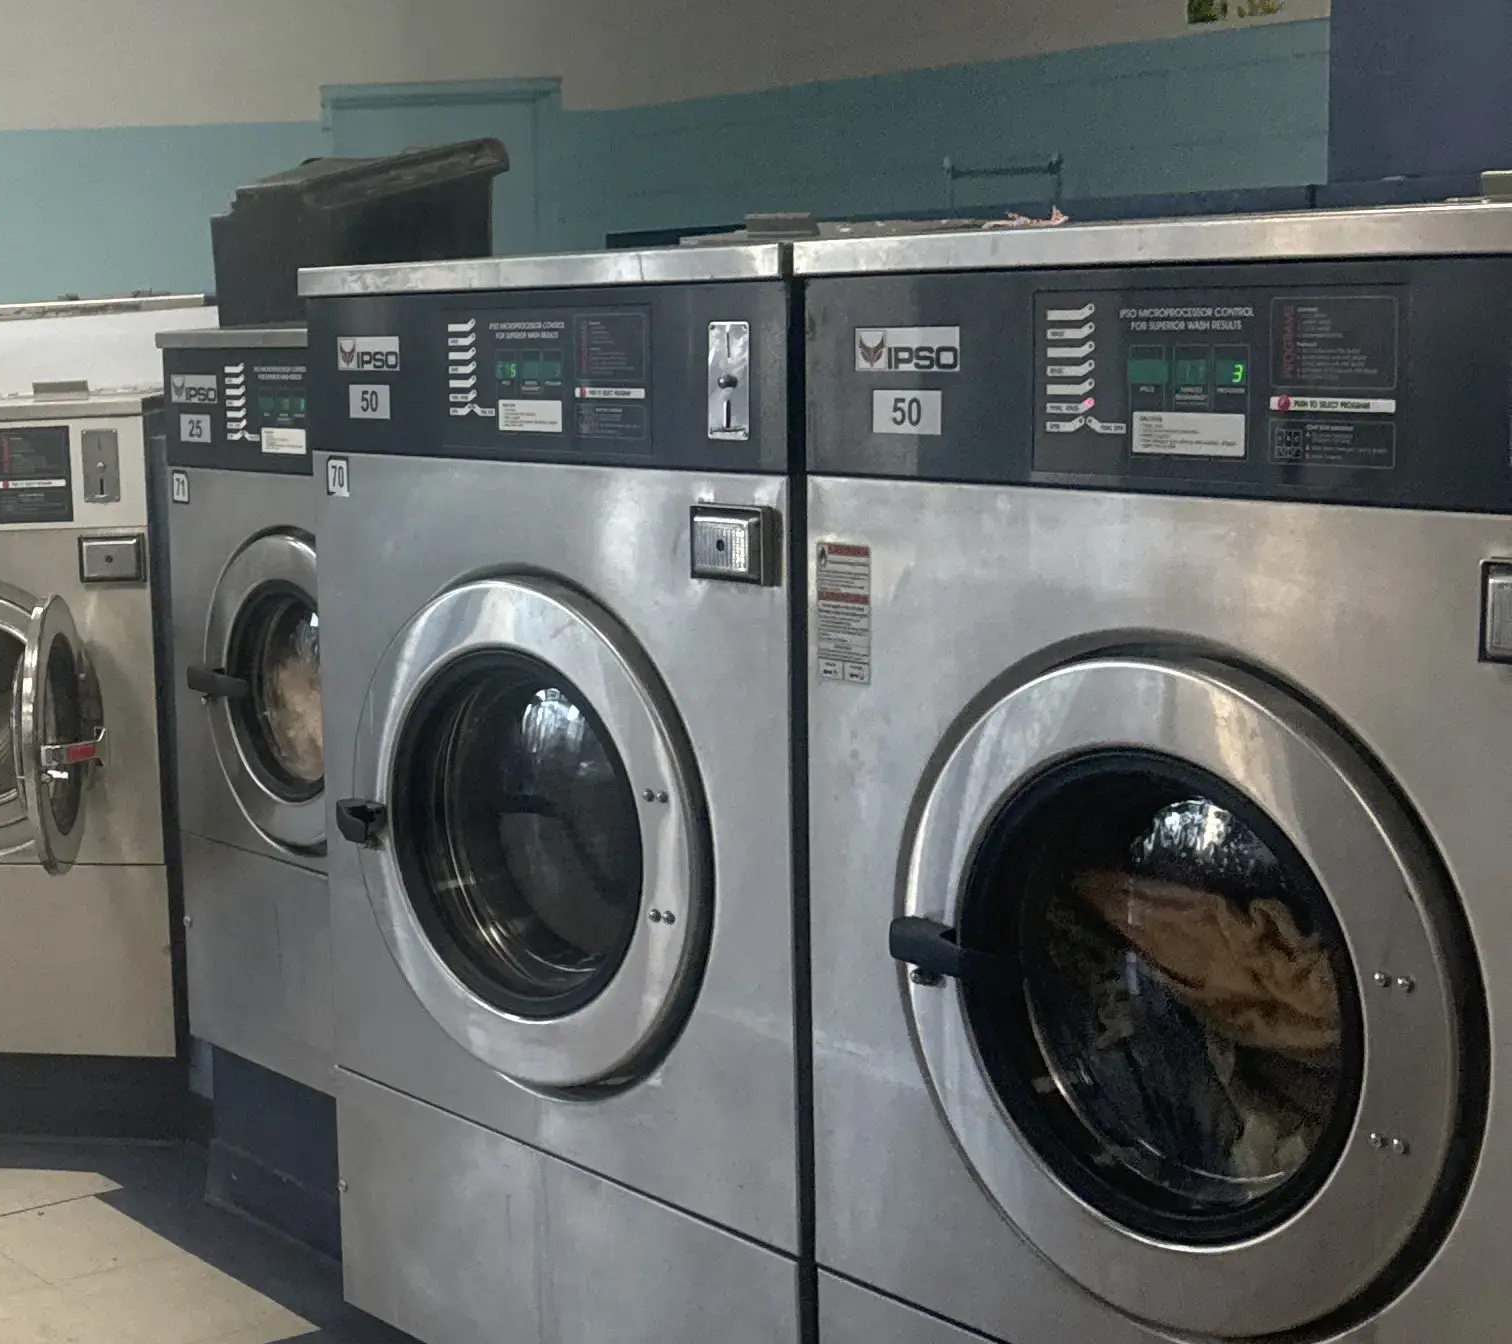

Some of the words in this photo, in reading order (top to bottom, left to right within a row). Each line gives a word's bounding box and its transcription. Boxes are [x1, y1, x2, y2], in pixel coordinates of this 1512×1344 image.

[356, 351, 399, 369] IPSO
[887, 345, 958, 370] IPSO
[1231, 363, 1244, 384] 3
[186, 387, 217, 402] IPSO
[360, 390, 379, 413] 50
[892, 397, 922, 427] 50
[188, 420, 202, 438] 25
[331, 465, 345, 488] 70
[175, 478, 186, 497] 71
